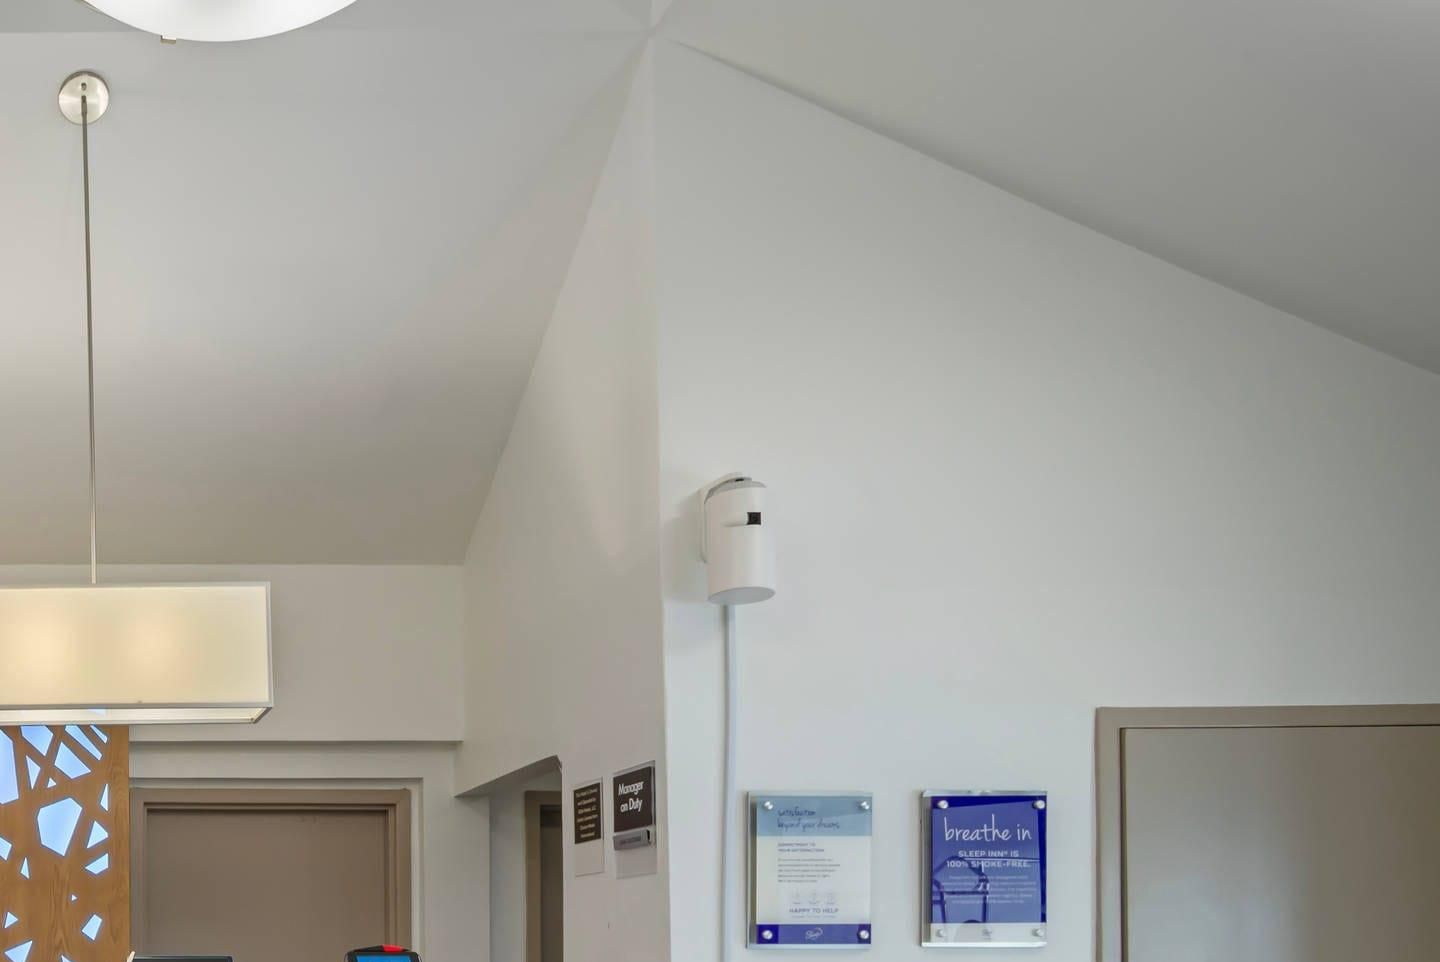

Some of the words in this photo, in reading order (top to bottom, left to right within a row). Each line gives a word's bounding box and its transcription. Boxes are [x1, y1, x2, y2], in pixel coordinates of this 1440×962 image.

[618, 781, 644, 796] Manager
[620, 803, 628, 812] on
[629, 798, 643, 812] Duty
[943, 813, 1011, 842] breathe
[1017, 824, 1032, 841] in
[958, 850, 986, 858] SLEEP
[1010, 850, 1020, 858] IS
